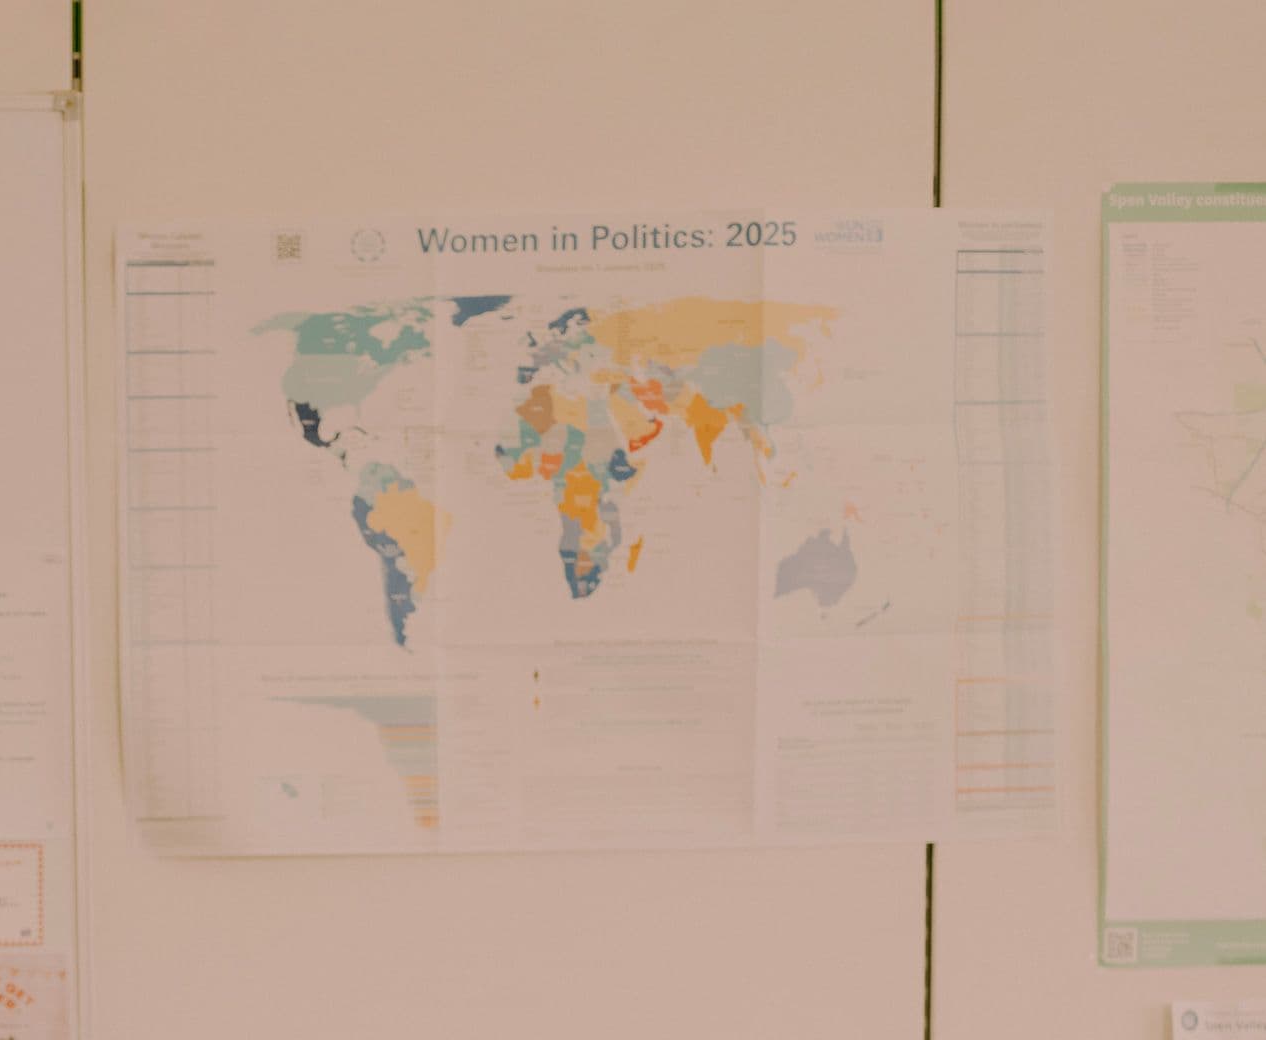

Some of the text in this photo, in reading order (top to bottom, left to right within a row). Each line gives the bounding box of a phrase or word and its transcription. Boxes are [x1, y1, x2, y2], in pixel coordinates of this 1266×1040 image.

[417, 221, 797, 254] Women in Politics: 2025
